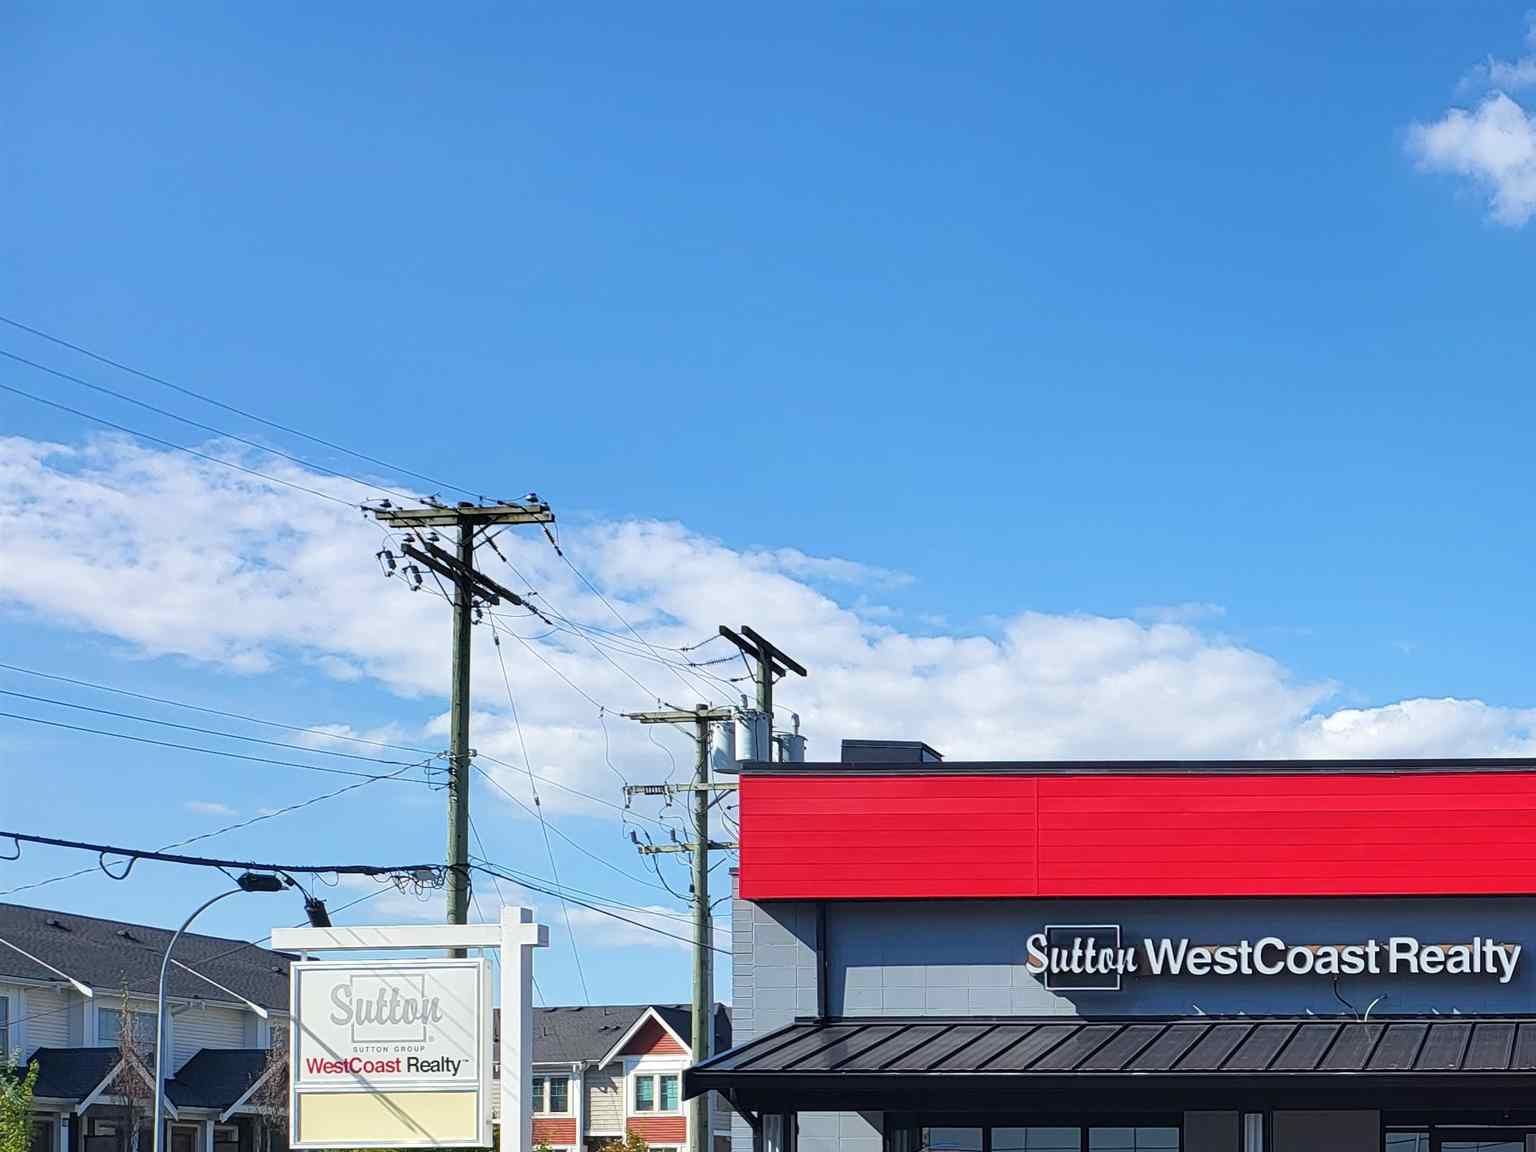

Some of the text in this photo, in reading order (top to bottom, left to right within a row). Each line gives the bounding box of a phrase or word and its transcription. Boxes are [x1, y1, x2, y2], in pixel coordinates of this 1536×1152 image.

[1026, 933, 1522, 984] Sutton WestCoast Realty
[330, 983, 443, 1026] Sutton
[306, 1056, 462, 1077] WestCoast Realty
